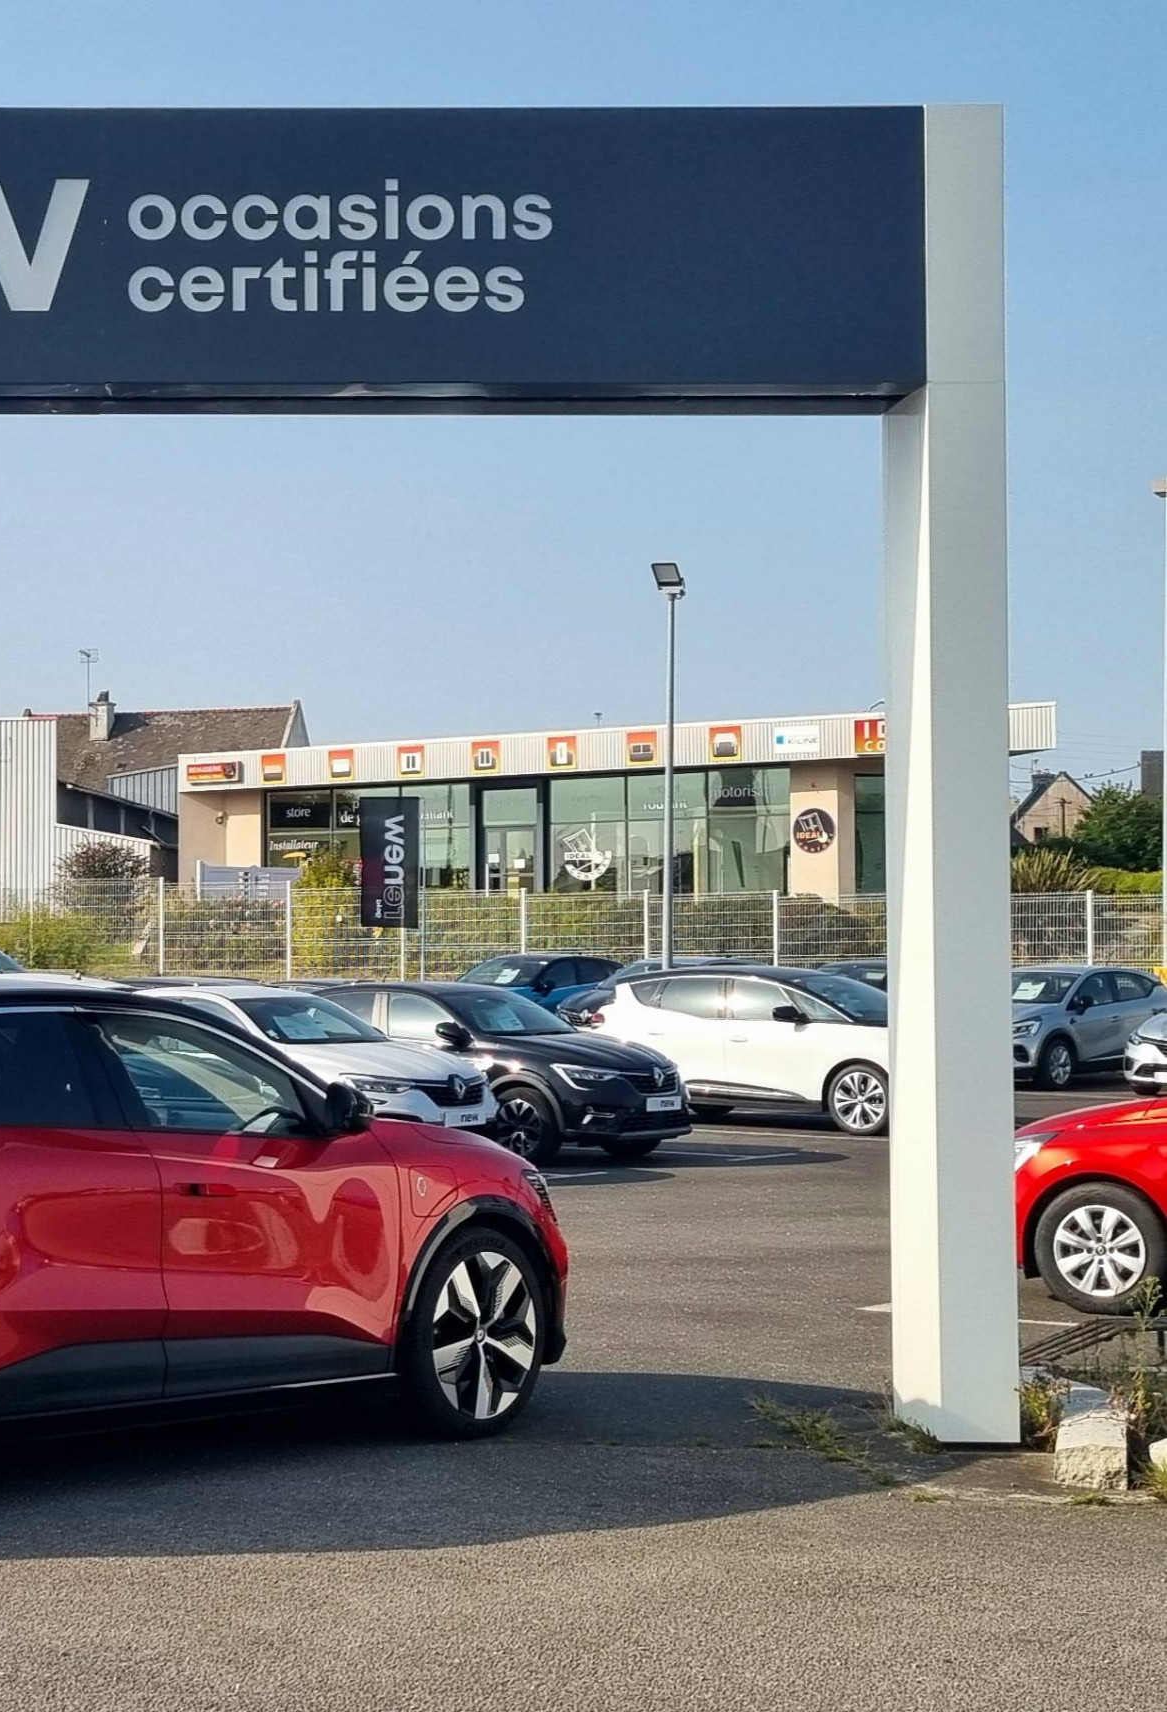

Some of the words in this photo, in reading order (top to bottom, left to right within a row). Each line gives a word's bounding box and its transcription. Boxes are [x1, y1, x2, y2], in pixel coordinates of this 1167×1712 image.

[128, 178, 554, 241] occasions
[128, 249, 526, 313] certifiées
[286, 806, 311, 818] store
[796, 831, 820, 839] IDEAL
[269, 840, 319, 851] Installateur
[460, 1113, 479, 1123] new
